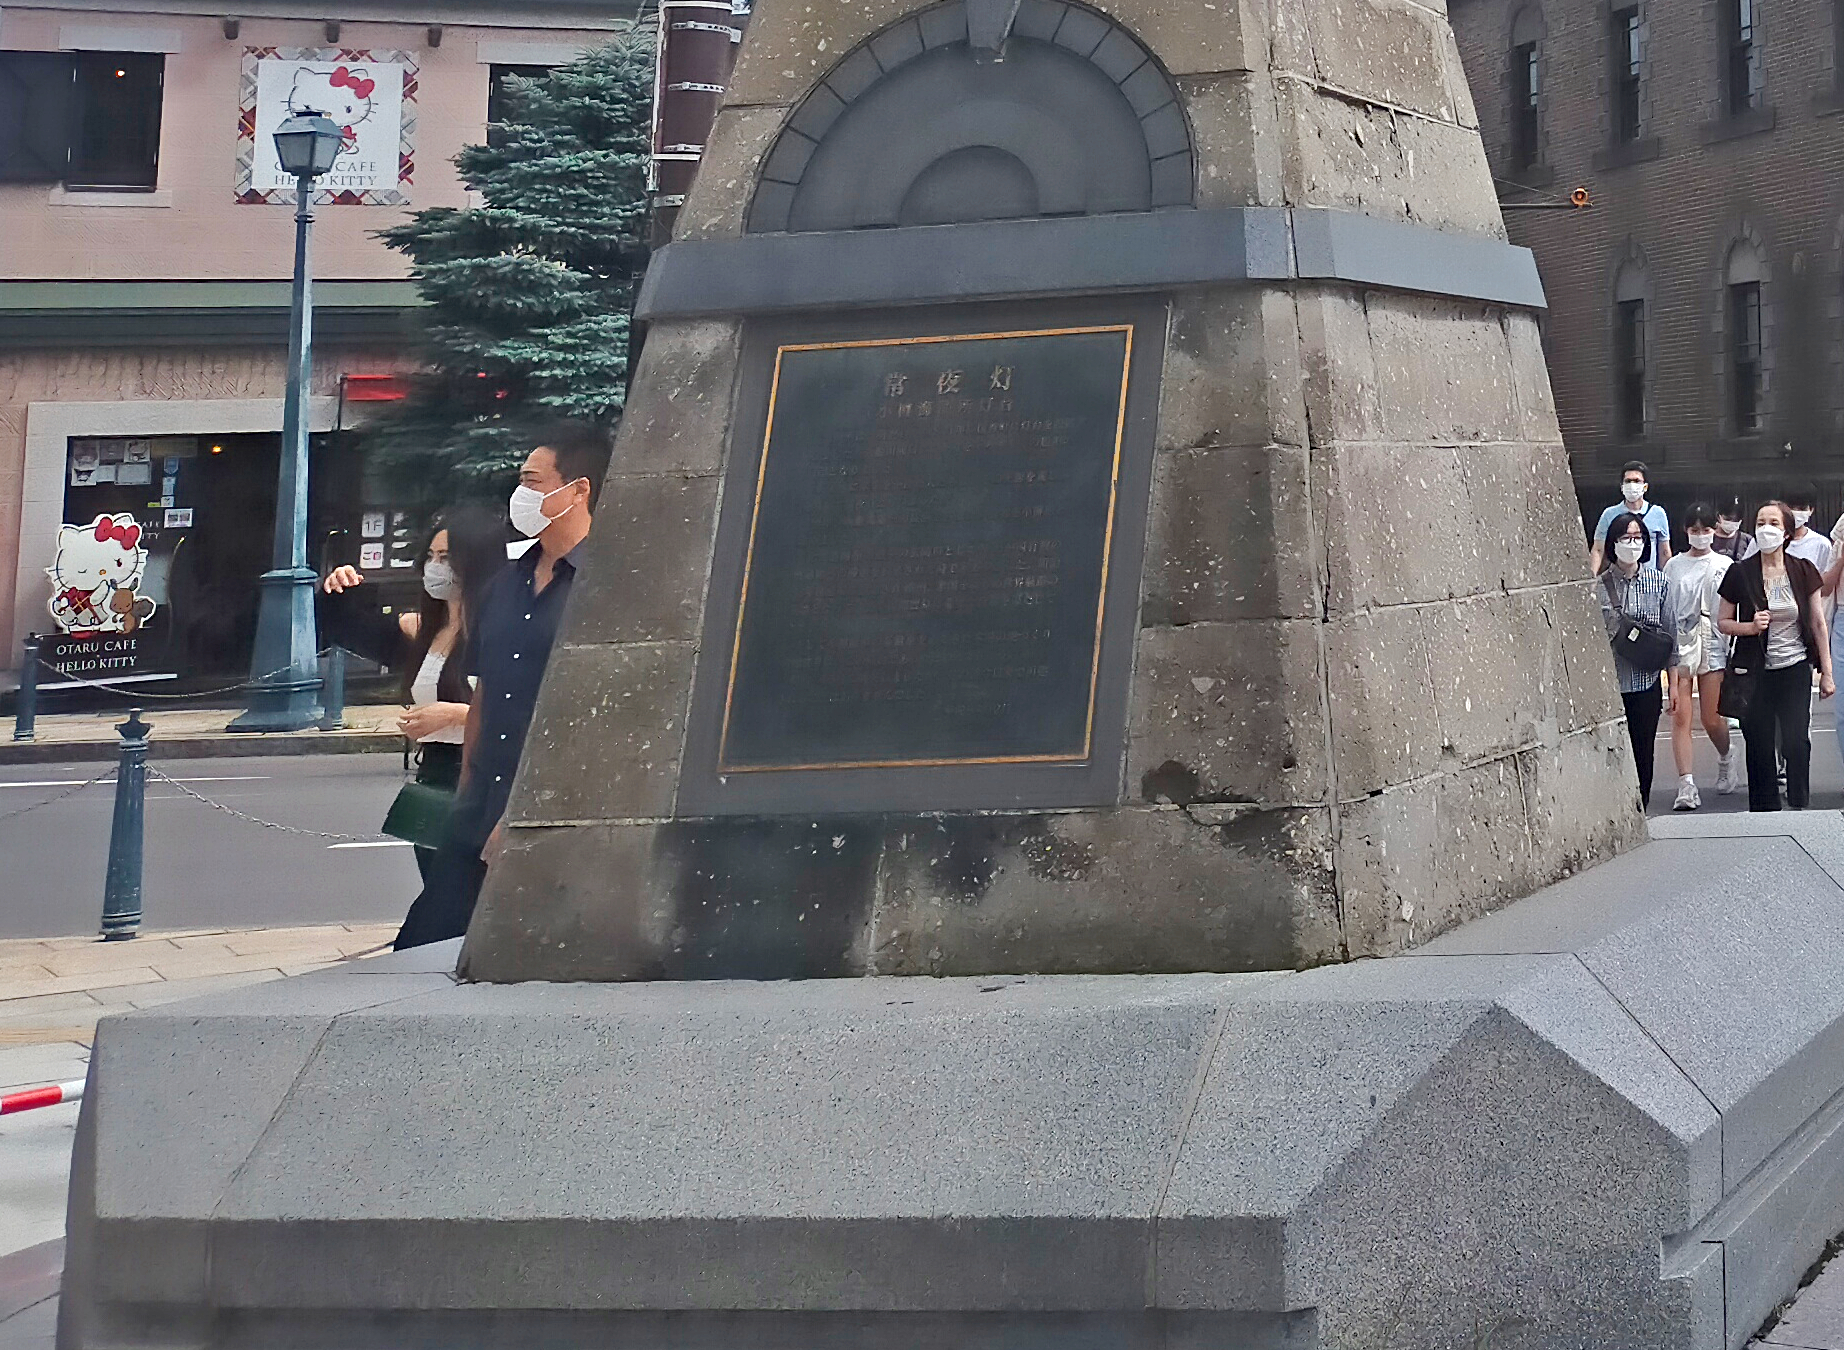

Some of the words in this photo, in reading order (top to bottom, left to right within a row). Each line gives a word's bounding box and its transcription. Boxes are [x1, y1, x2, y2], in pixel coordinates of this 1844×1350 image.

[335, 161, 377, 172] CAFE
[330, 175, 377, 186] KITTY
[56, 642, 99, 655] OTARU
[104, 639, 137, 652] CAFE
[56, 660, 96, 672] HELLO
[99, 656, 137, 669] KITTY
